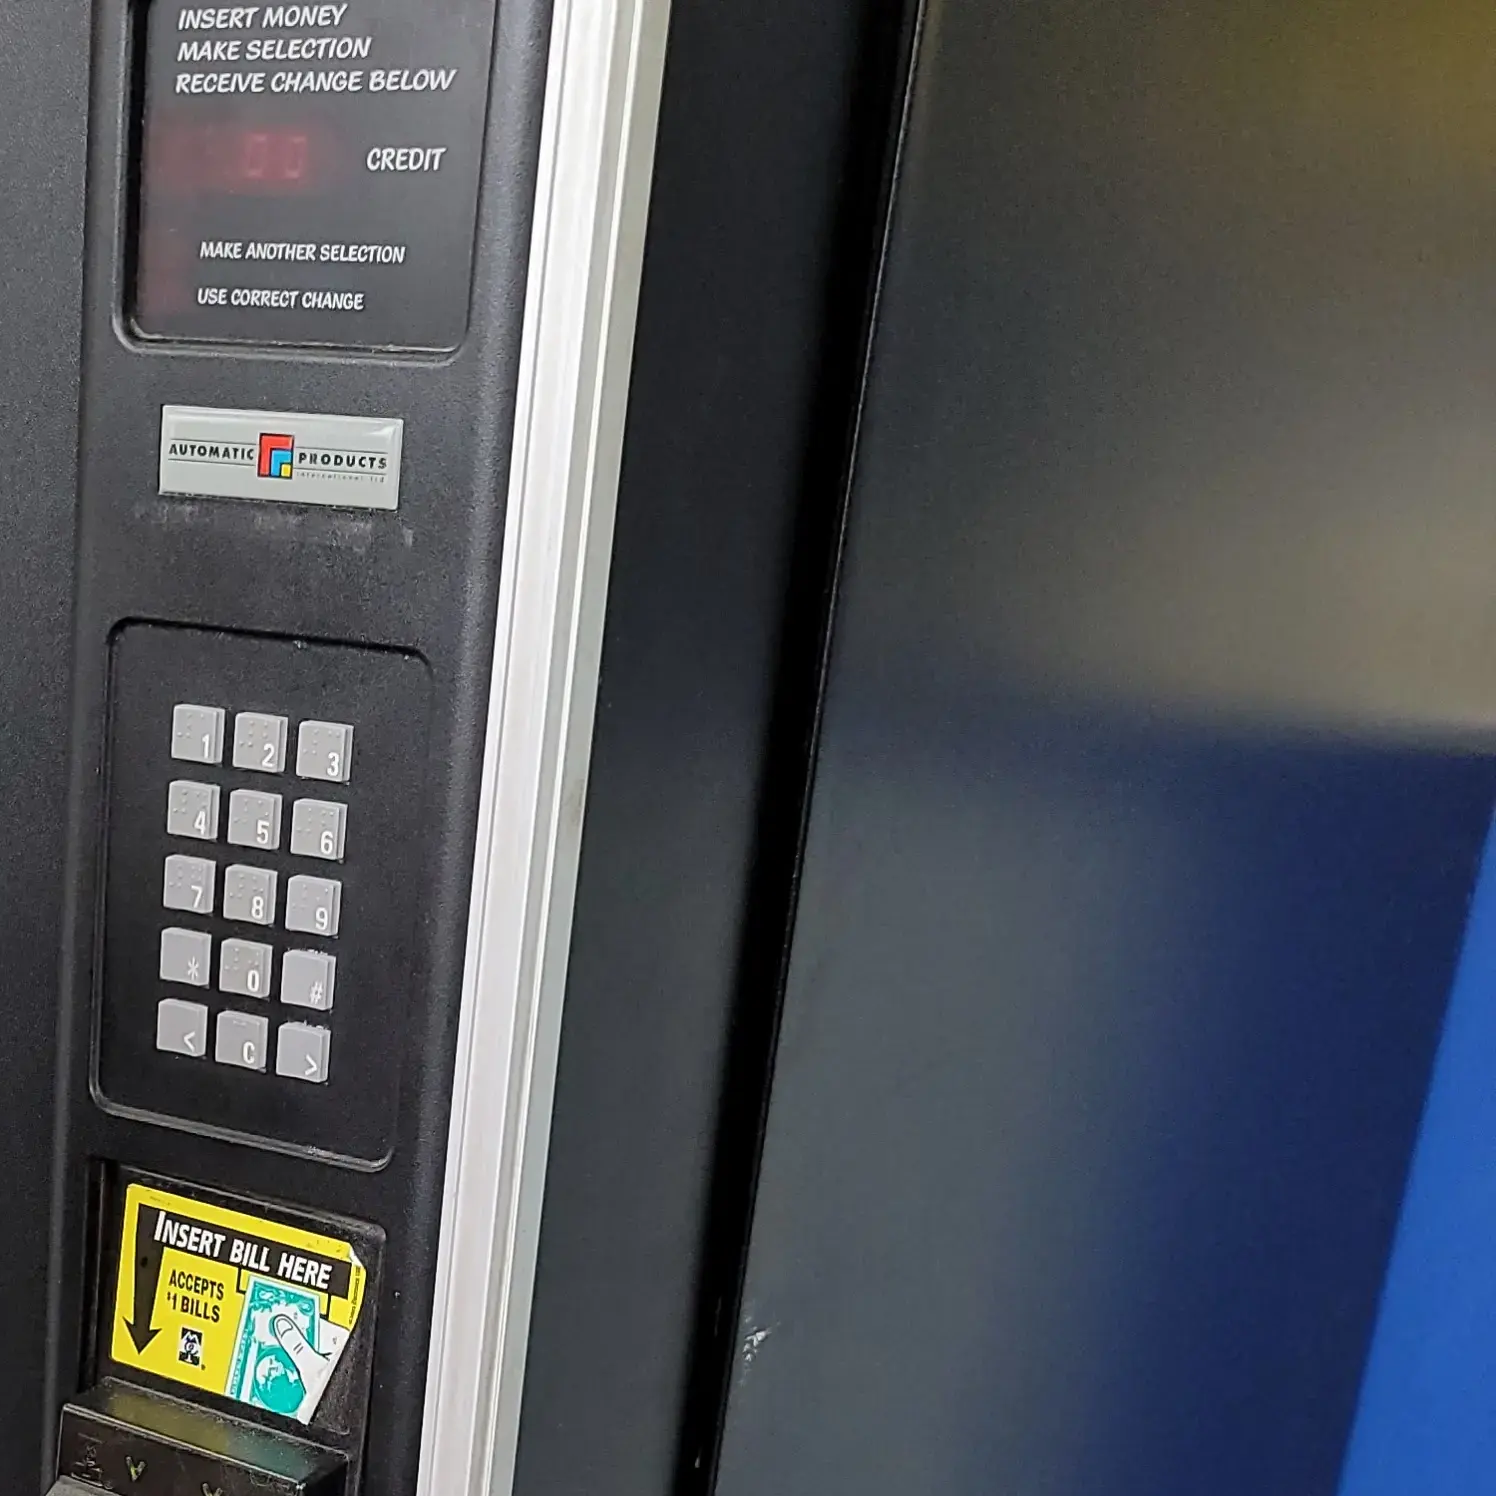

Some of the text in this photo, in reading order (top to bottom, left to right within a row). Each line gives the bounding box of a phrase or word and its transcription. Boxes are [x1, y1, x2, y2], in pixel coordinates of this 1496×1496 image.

[178, 4, 347, 30] INSERT MONEY
[177, 36, 371, 61] MAKE SELECTION
[175, 69, 456, 94] RECEIVE CHANGE BELOW
[366, 147, 447, 171] CREDIT
[199, 241, 405, 264] MAKE ANOTHER SELECTION
[197, 288, 364, 311] USE CORRECT CHANGE
[168, 443, 387, 470] AUTOMATIC PRODUCTS
[201, 733, 341, 777] 1 2 3
[194, 810, 334, 855] 4 5 6
[191, 885, 329, 931] 7 8 9
[247, 969, 260, 993] 0
[242, 1041, 255, 1065] C
[154, 1211, 333, 1289] INSERT BILL HERE
[168, 1268, 225, 1301] ACCEPTS
[180, 1296, 220, 1323] BILLS
